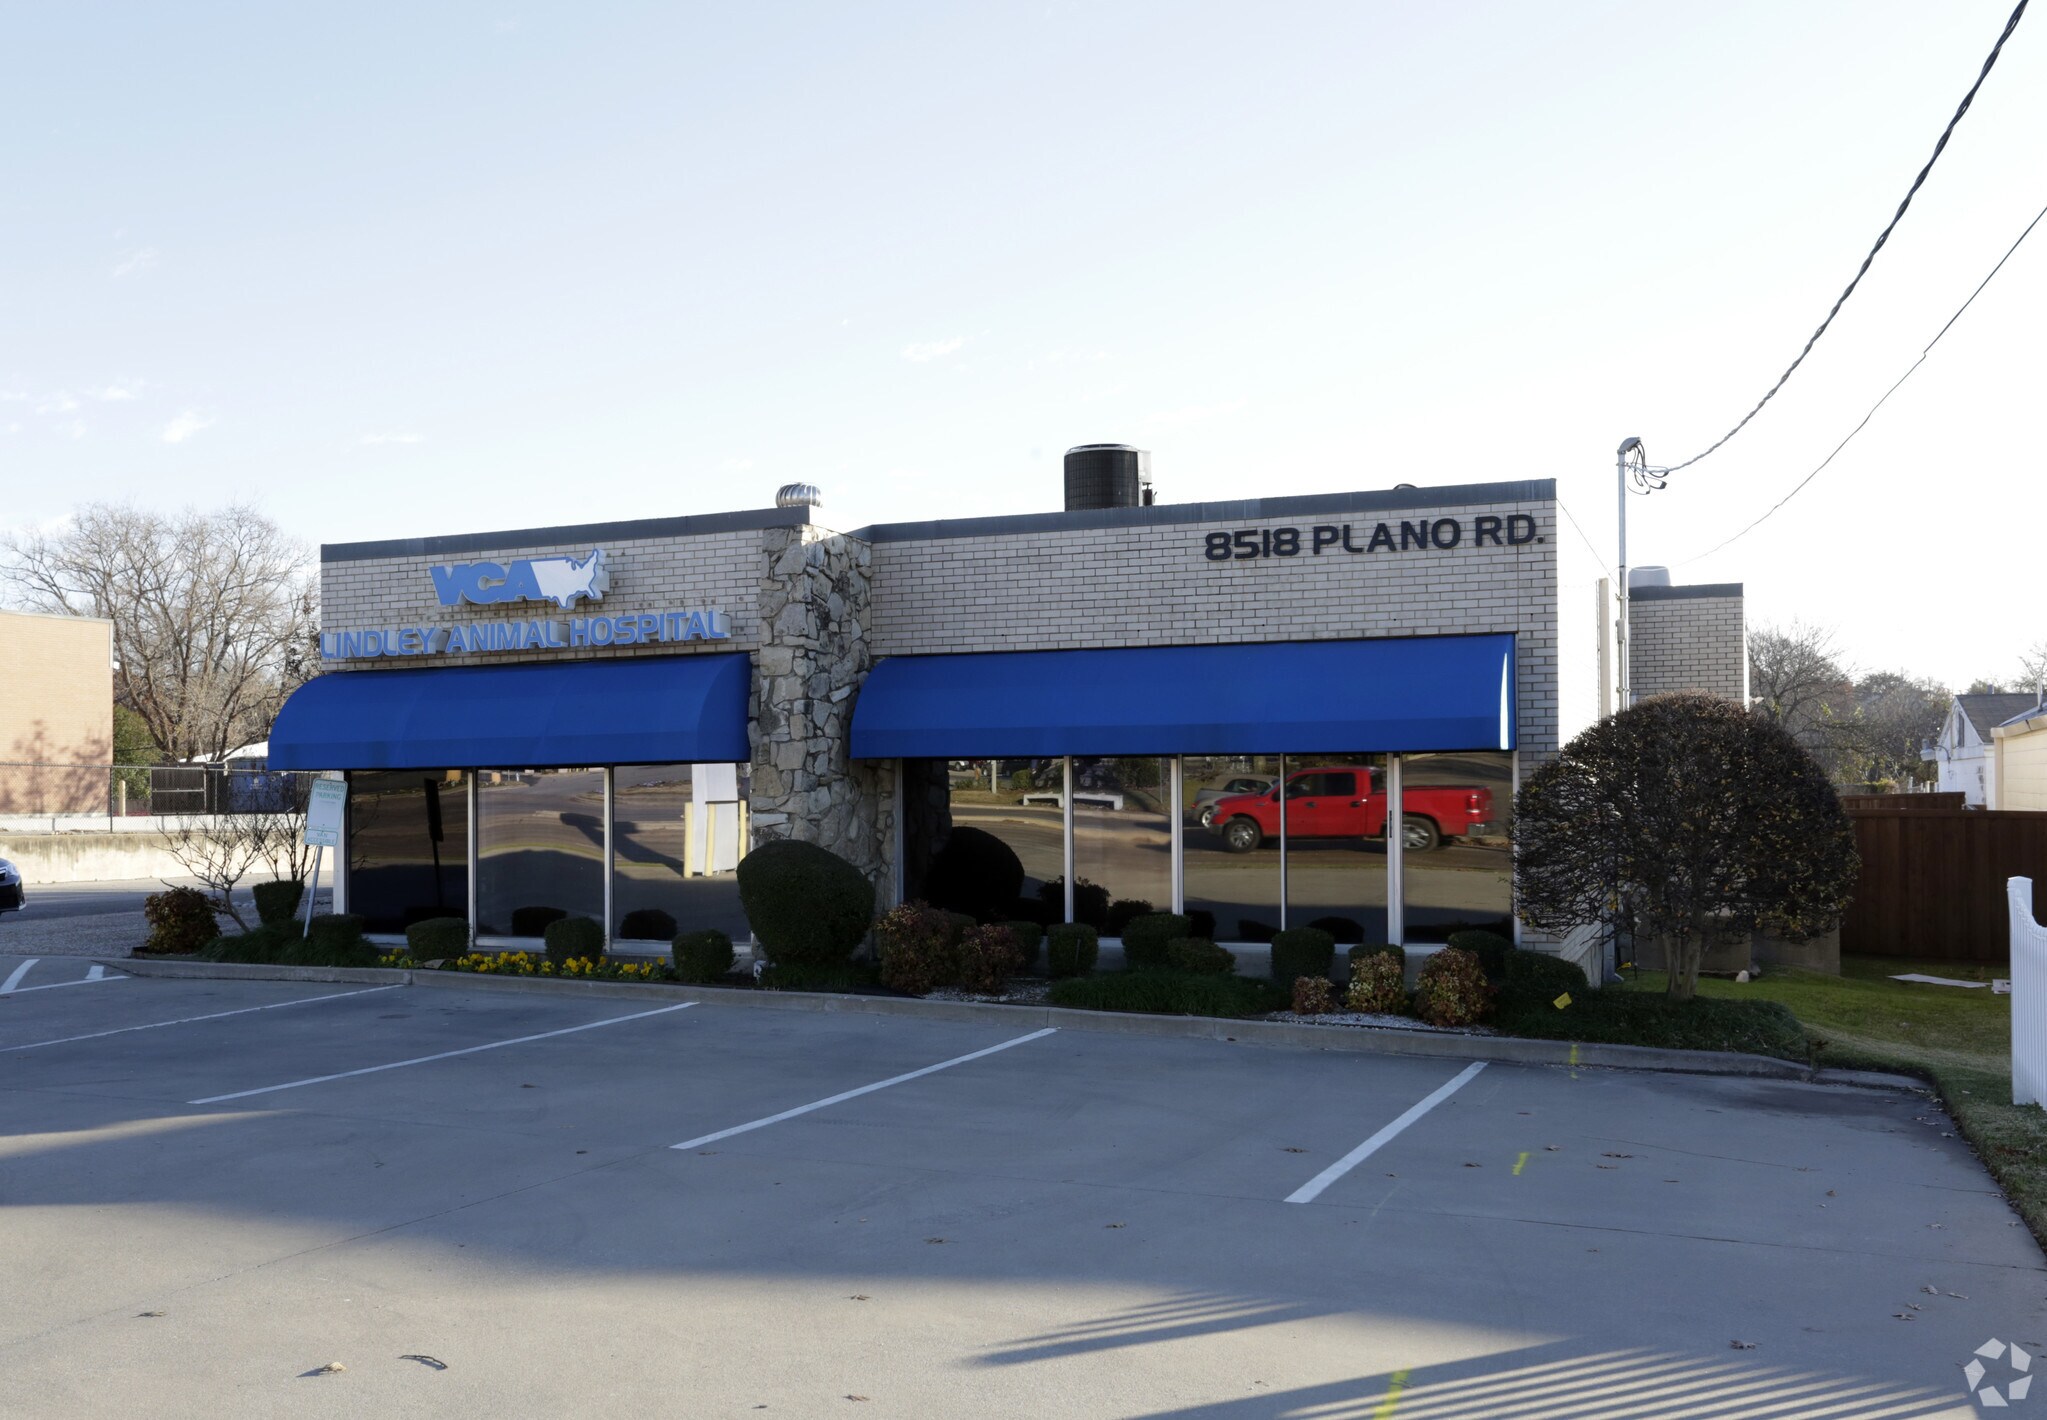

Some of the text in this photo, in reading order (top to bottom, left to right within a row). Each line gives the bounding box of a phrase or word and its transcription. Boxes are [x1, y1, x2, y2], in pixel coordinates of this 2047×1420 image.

[1205, 514, 1544, 561] 8518 PLANO RD.
[430, 559, 544, 606] VCA
[320, 610, 727, 659] LINDLEY ANIMAL HOSPITAL
[315, 783, 345, 793] RESERVED
[315, 792, 342, 801] PARKING
